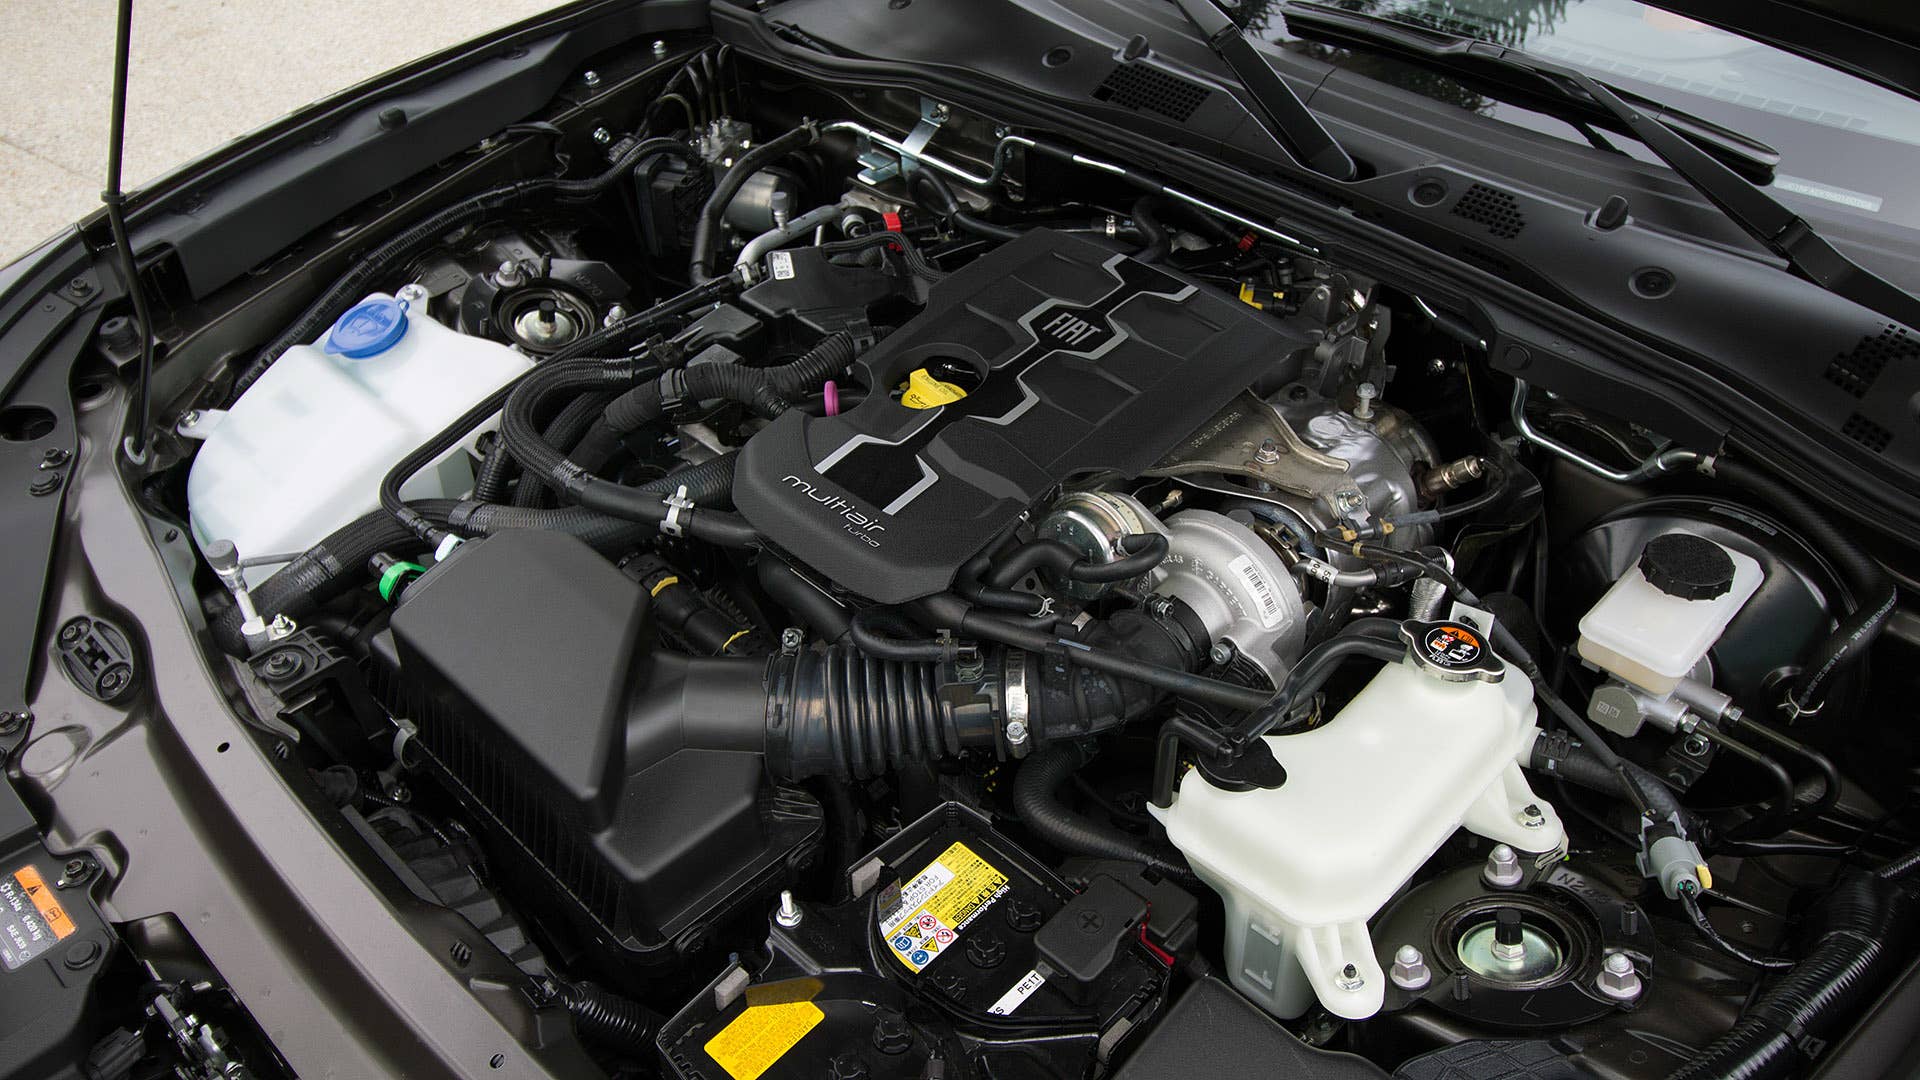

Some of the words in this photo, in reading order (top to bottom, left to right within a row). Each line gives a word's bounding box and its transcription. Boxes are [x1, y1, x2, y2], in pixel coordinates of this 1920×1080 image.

[1042, 312, 1102, 346] FIAT
[782, 475, 885, 531] multiair
[843, 523, 880, 548] turbo
[924, 875, 938, 887] FOR
[908, 884, 926, 901] STOP
[993, 884, 1010, 899] High
[954, 903, 975, 923] DANGER
[958, 898, 996, 930] Performance
[6, 924, 18, 938] SAE
